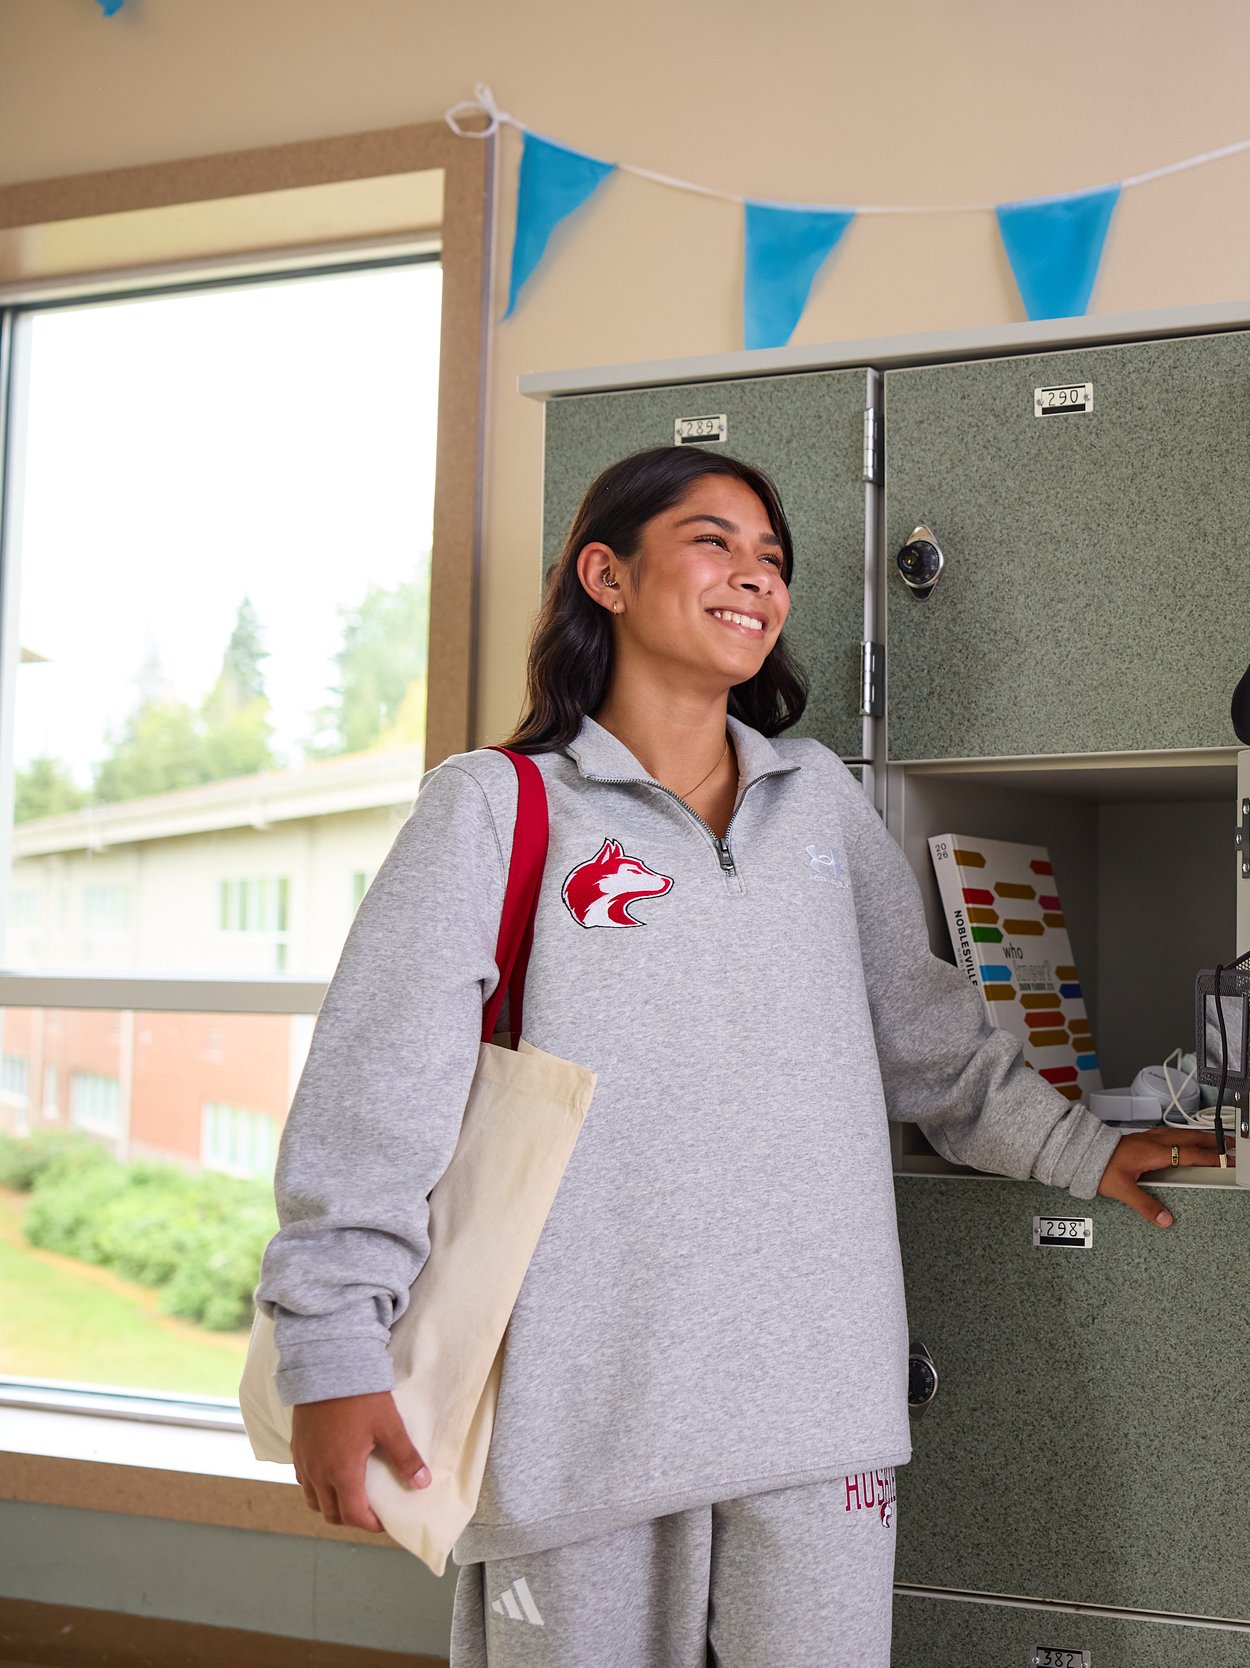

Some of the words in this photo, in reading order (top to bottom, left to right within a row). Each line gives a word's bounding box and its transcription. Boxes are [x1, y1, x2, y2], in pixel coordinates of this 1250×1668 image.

[1048, 389, 1079, 406] 290
[686, 420, 714, 436] 289
[935, 842, 947, 852] 20
[937, 851, 949, 860] 26
[1002, 942, 1023, 959] who
[1046, 1221, 1078, 1237] 298
[1043, 1650, 1075, 1668] 382
